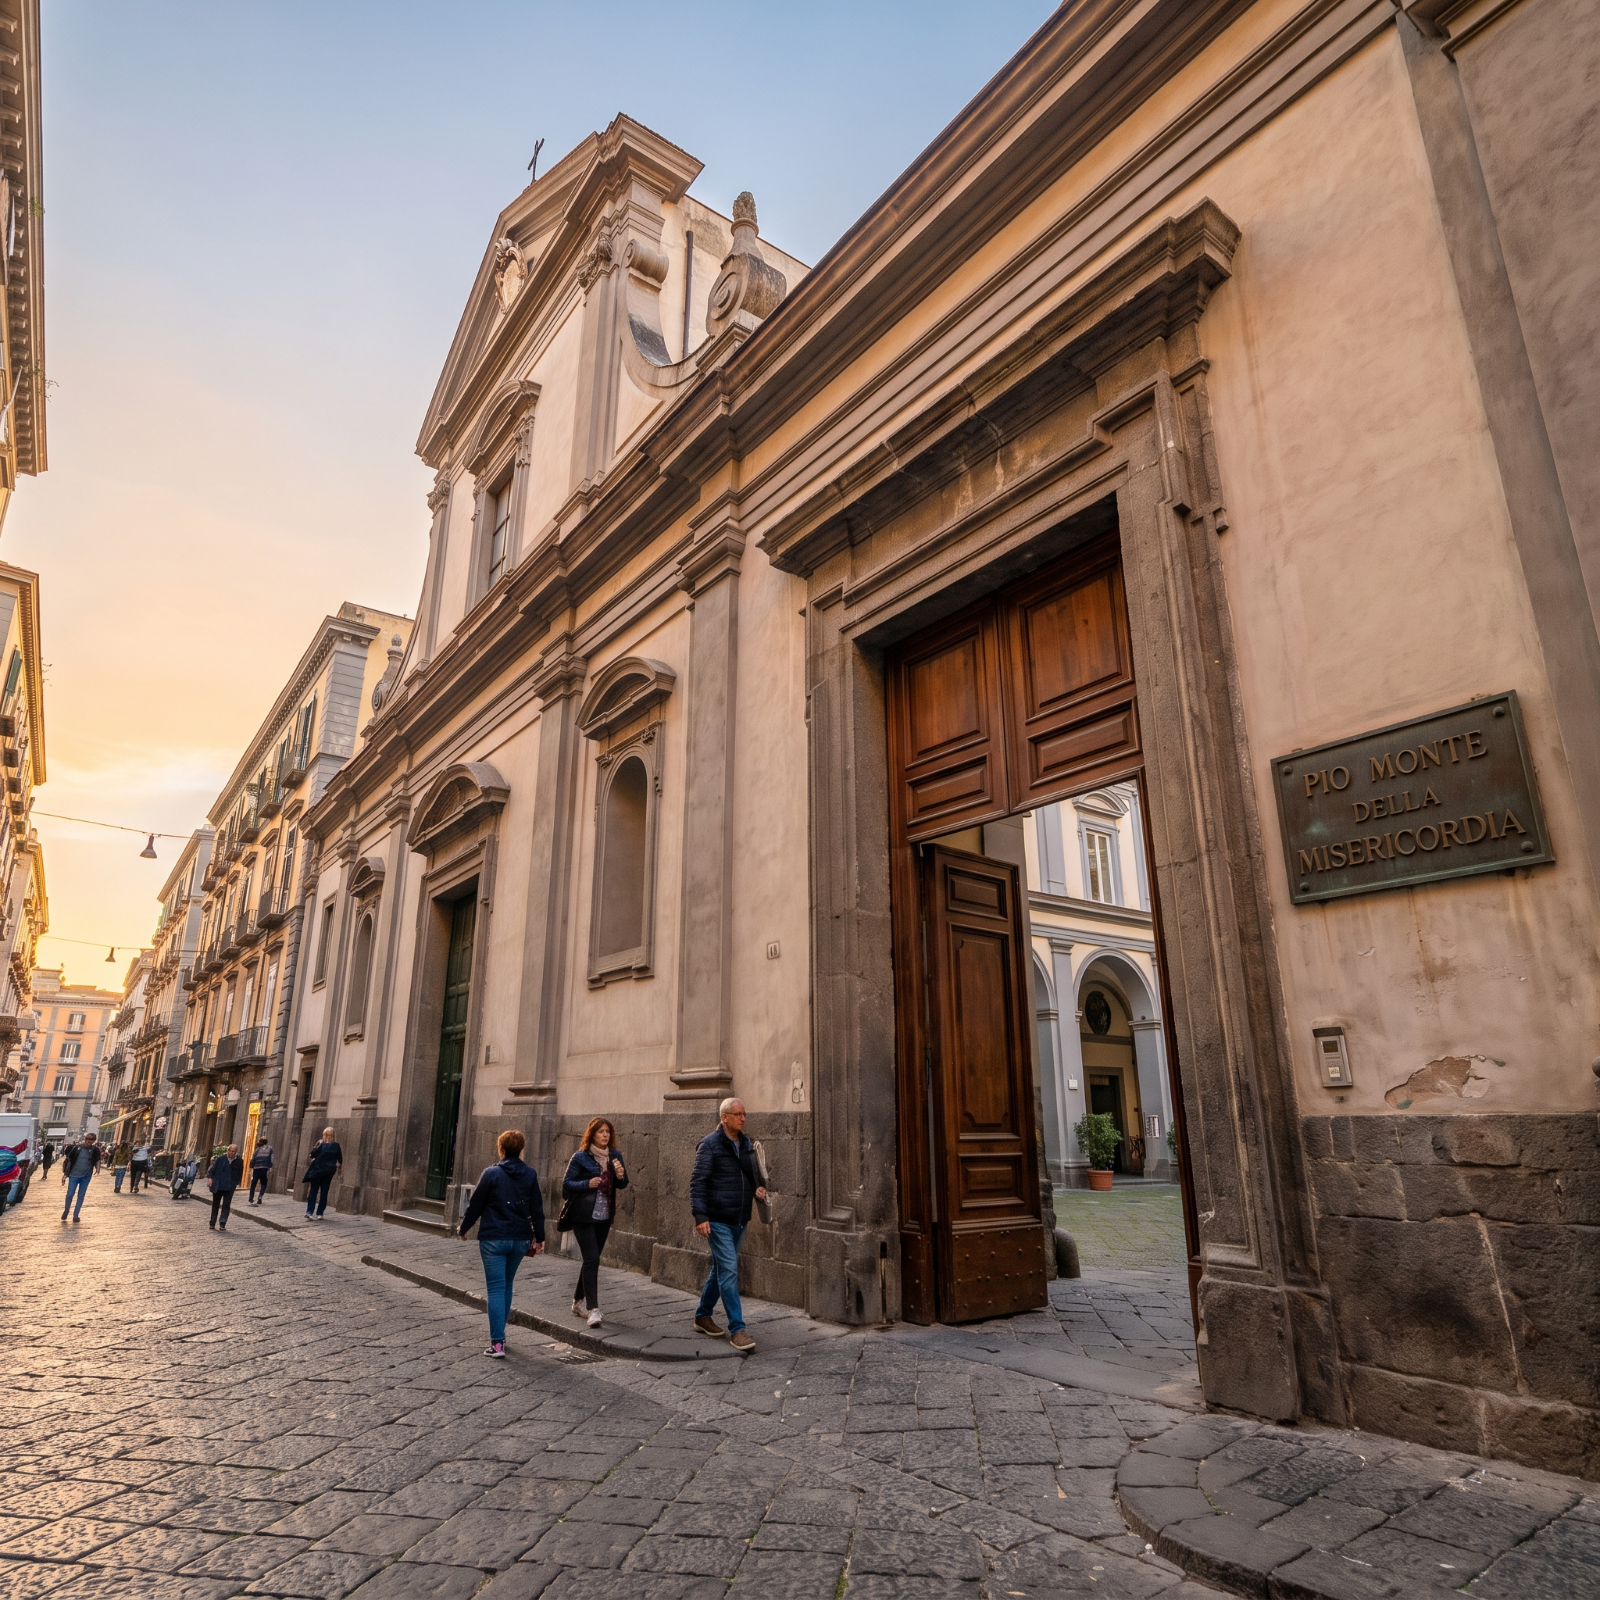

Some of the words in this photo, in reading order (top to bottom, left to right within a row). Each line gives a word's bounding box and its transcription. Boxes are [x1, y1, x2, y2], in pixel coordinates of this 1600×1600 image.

[1303, 766, 1350, 798] PIO
[1369, 729, 1488, 782] MONTE
[1351, 786, 1442, 823] DELLA
[1298, 808, 1527, 875] MISERICORDIA
